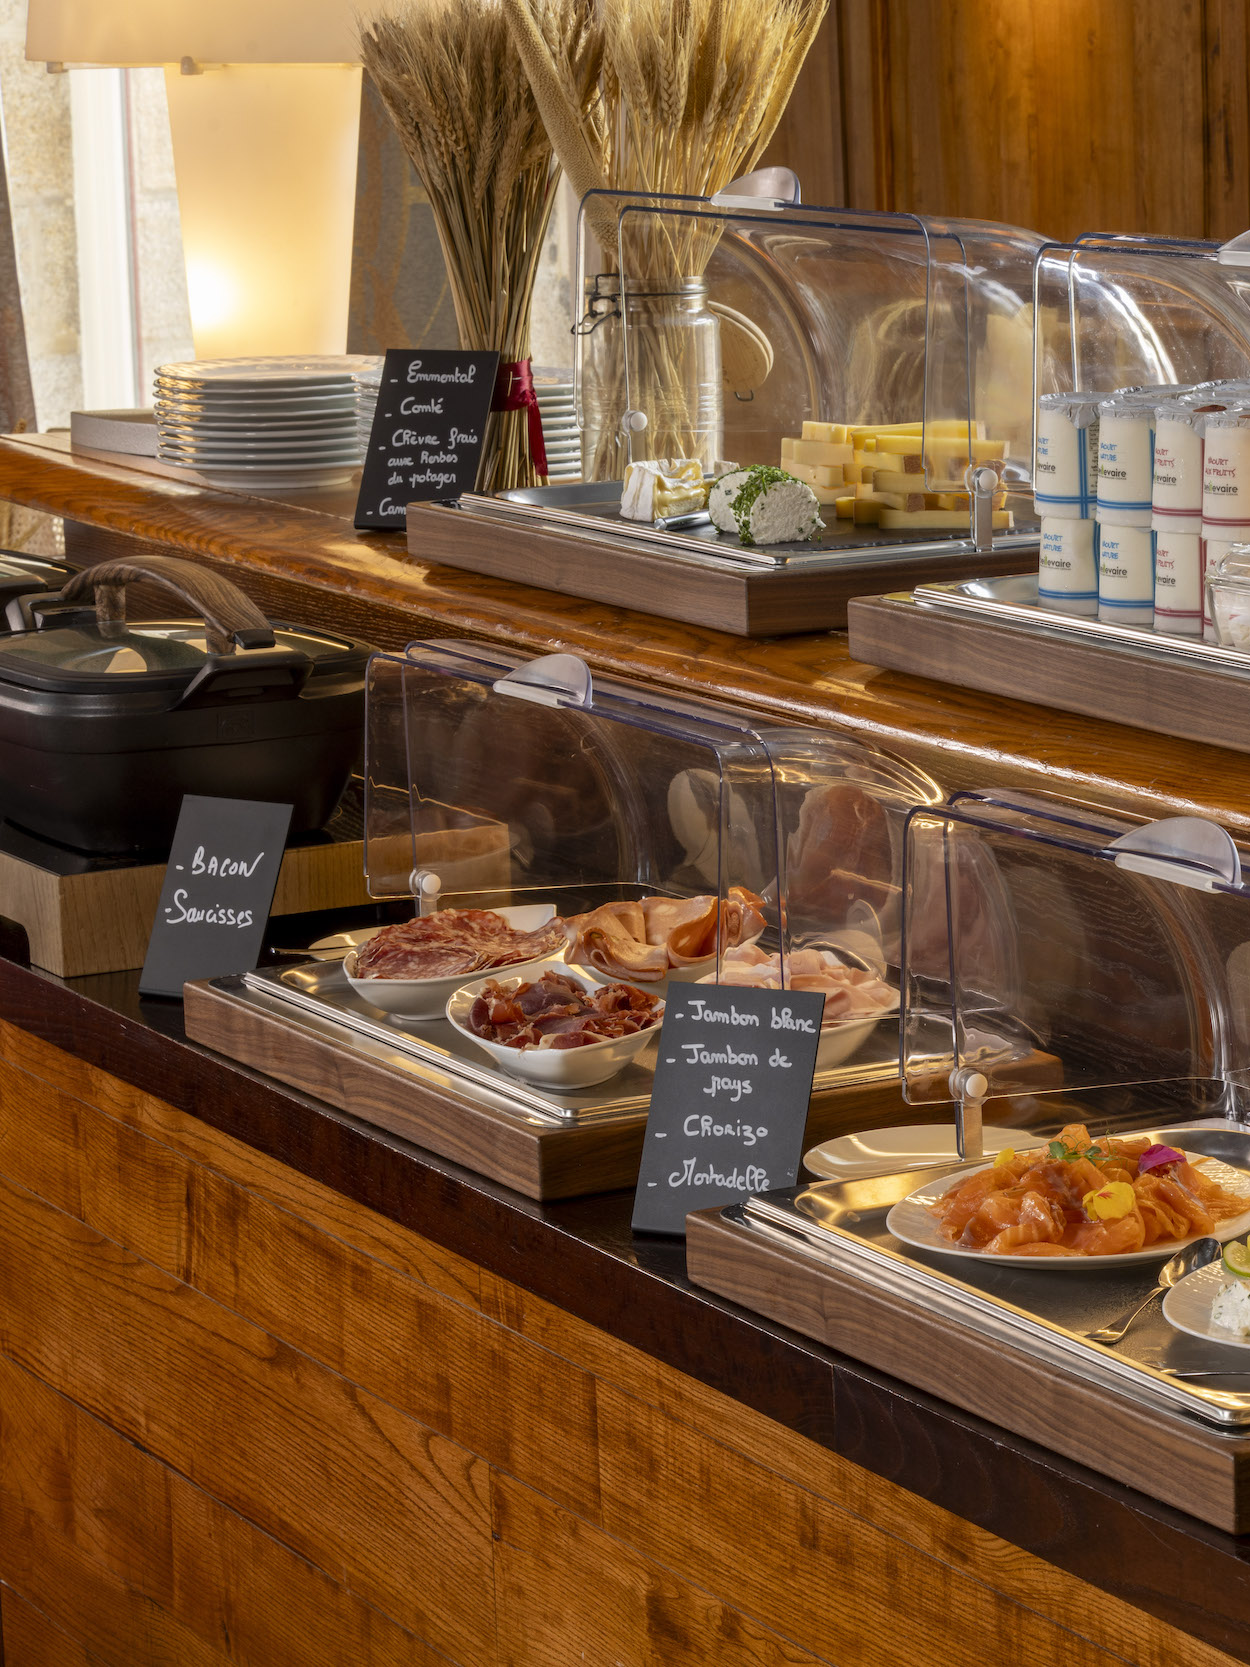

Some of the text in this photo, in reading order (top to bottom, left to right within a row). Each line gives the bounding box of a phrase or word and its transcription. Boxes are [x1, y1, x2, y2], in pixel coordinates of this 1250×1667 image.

[400, 397, 444, 415] Comté
[391, 429, 440, 447] Chèvre
[447, 427, 478, 449] frais
[388, 456, 414, 467] aux
[387, 469, 457, 489] du potager
[191, 845, 264, 877] BACON
[687, 1000, 760, 1027] Jambon
[769, 1006, 817, 1034] blanc
[681, 1043, 759, 1066] Jambon
[768, 1047, 793, 1068] de
[702, 1075, 754, 1103] pays
